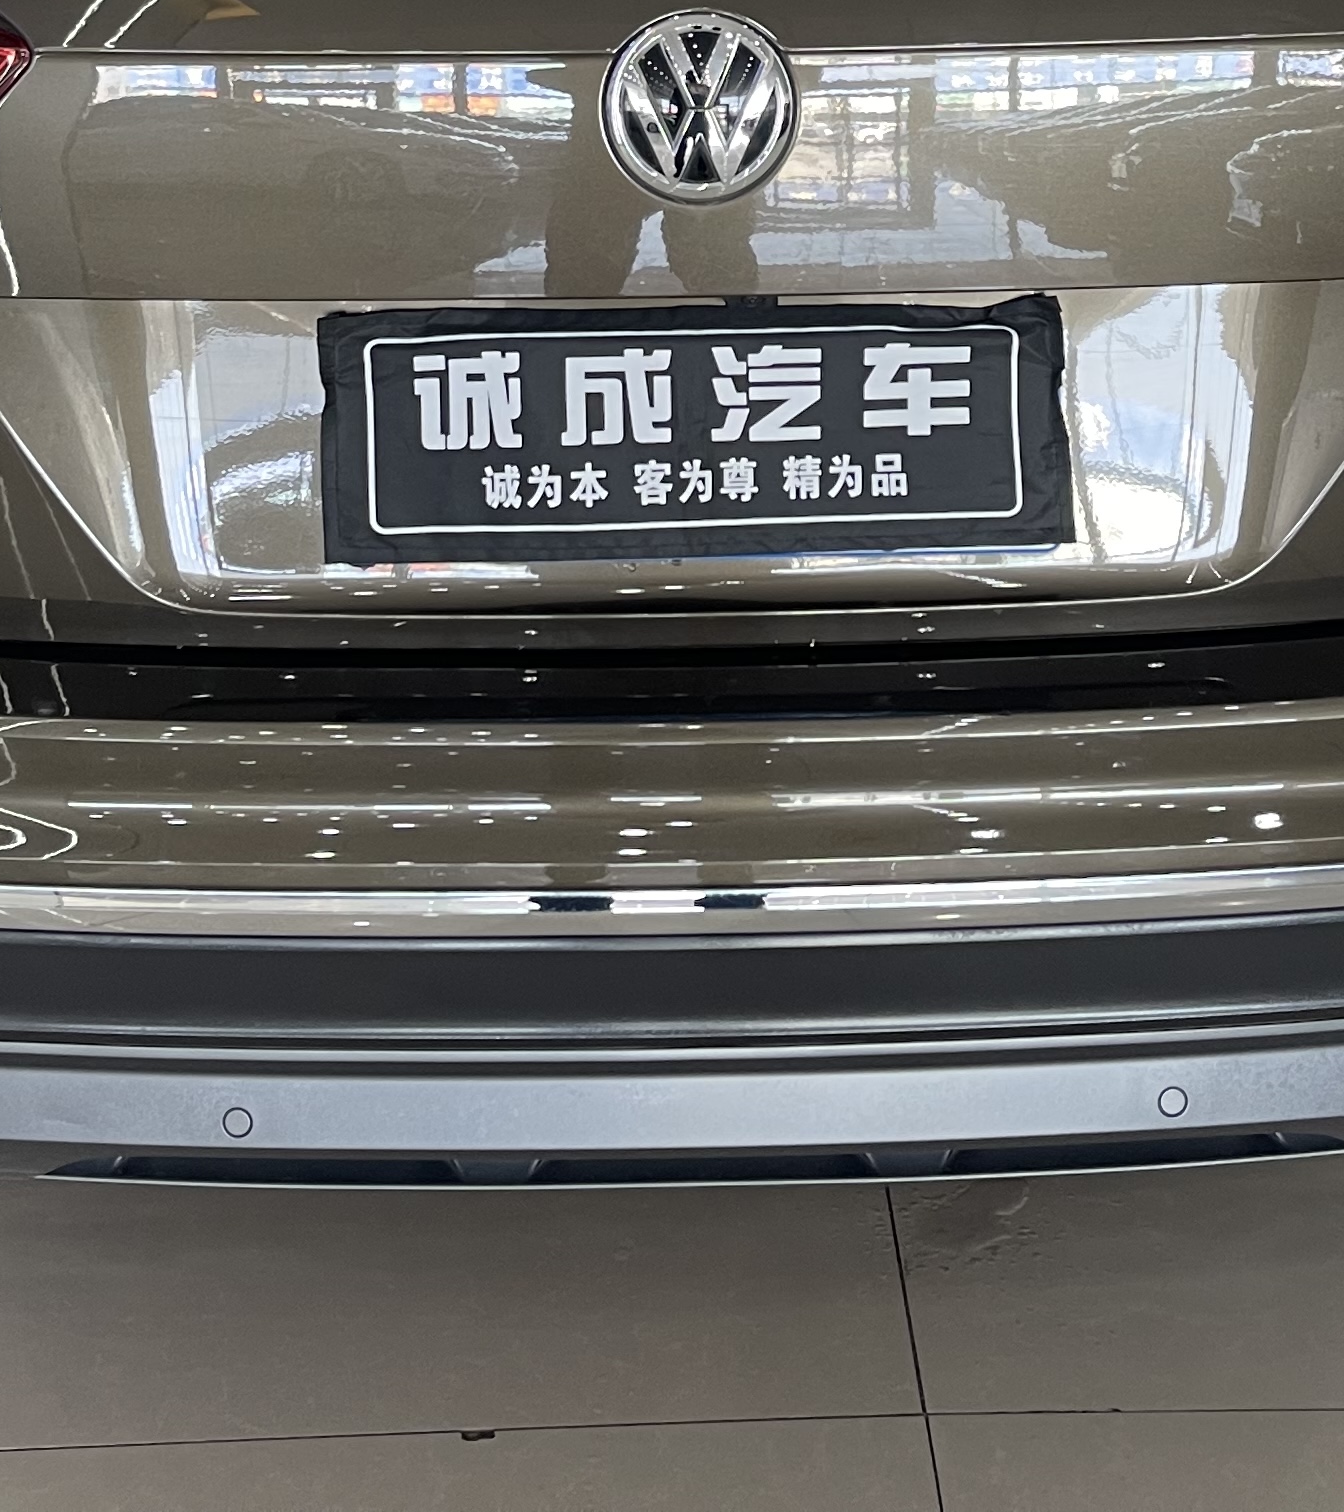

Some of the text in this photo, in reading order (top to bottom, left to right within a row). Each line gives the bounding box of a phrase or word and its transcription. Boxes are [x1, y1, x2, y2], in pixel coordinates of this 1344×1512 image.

[411, 342, 973, 452] 诚成汽车
[481, 453, 910, 511] 诚为本 客为尊 精为品
